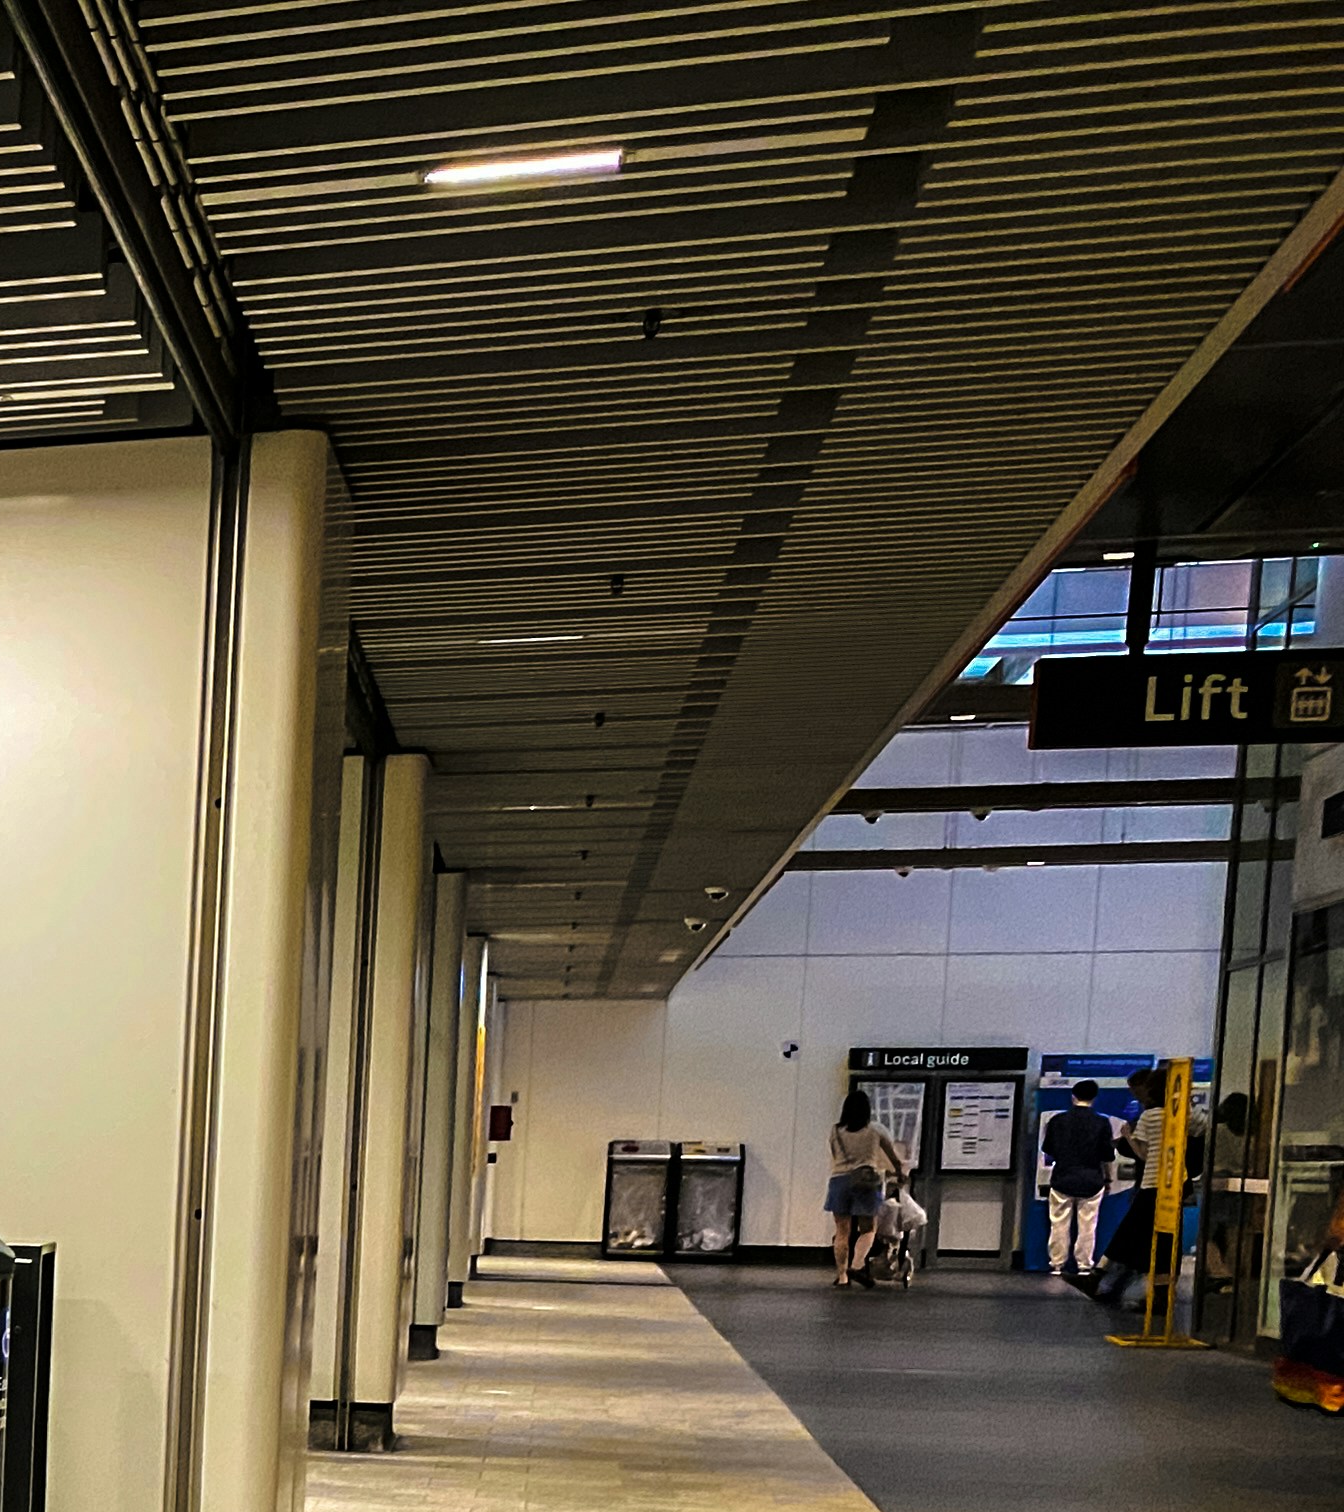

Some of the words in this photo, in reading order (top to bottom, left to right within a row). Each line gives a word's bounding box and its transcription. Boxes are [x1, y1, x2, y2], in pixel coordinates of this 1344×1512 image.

[1144, 673, 1249, 722] Lift
[884, 1053, 924, 1065] Local
[926, 1053, 969, 1068] guide
